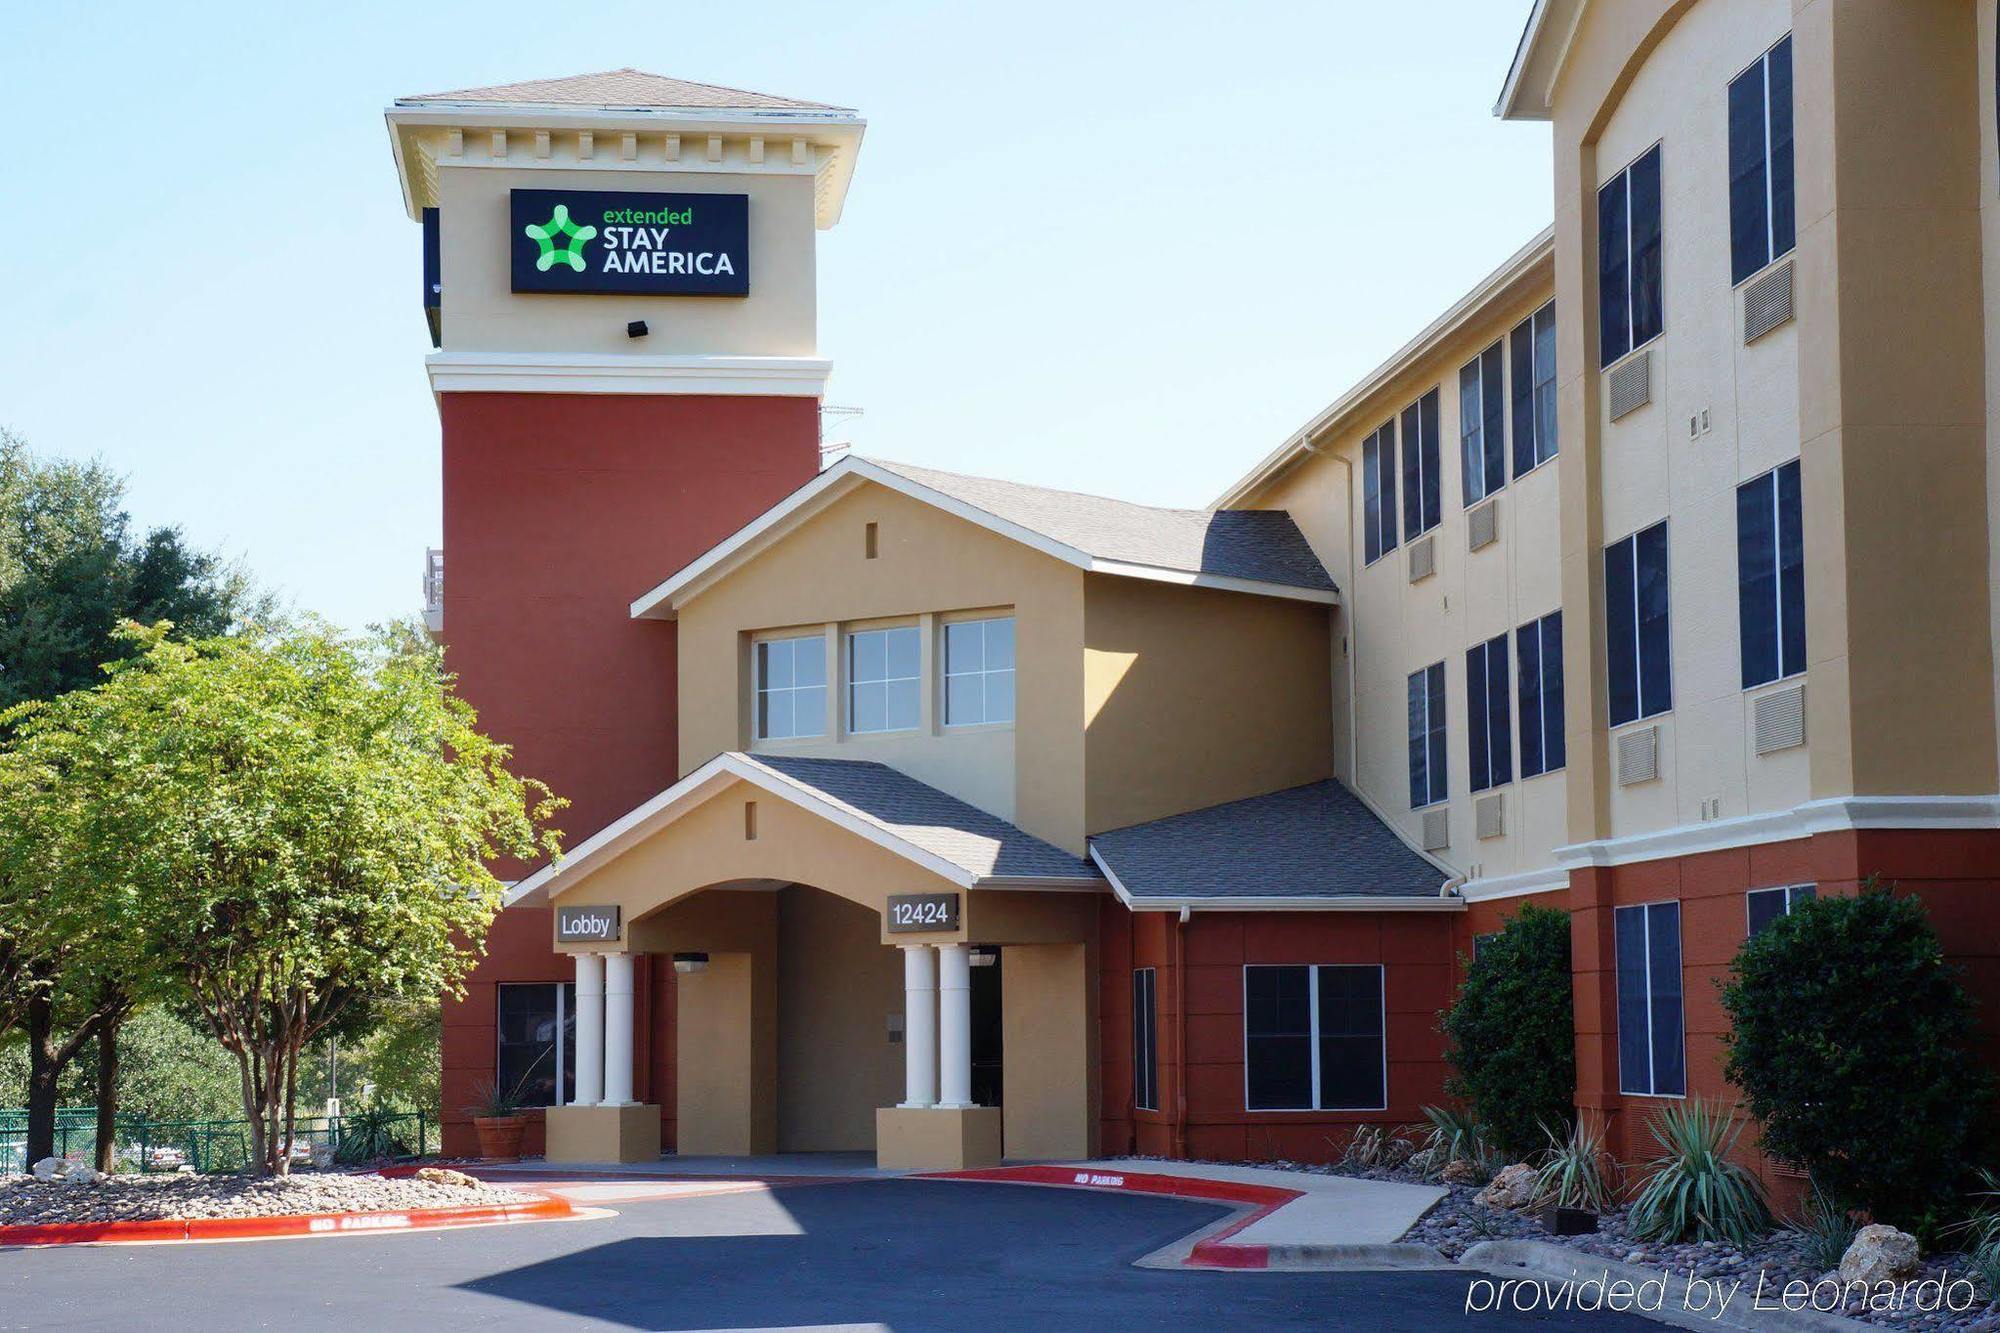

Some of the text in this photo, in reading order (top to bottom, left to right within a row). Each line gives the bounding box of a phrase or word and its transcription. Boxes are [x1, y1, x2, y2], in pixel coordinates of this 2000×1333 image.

[603, 207, 692, 225] extended
[603, 227, 669, 250] STAY
[603, 251, 735, 275] AMERICA
[893, 902, 948, 925] 12424
[562, 914, 610, 938] Lobby
[1074, 1173, 1124, 1186] NO PARKING
